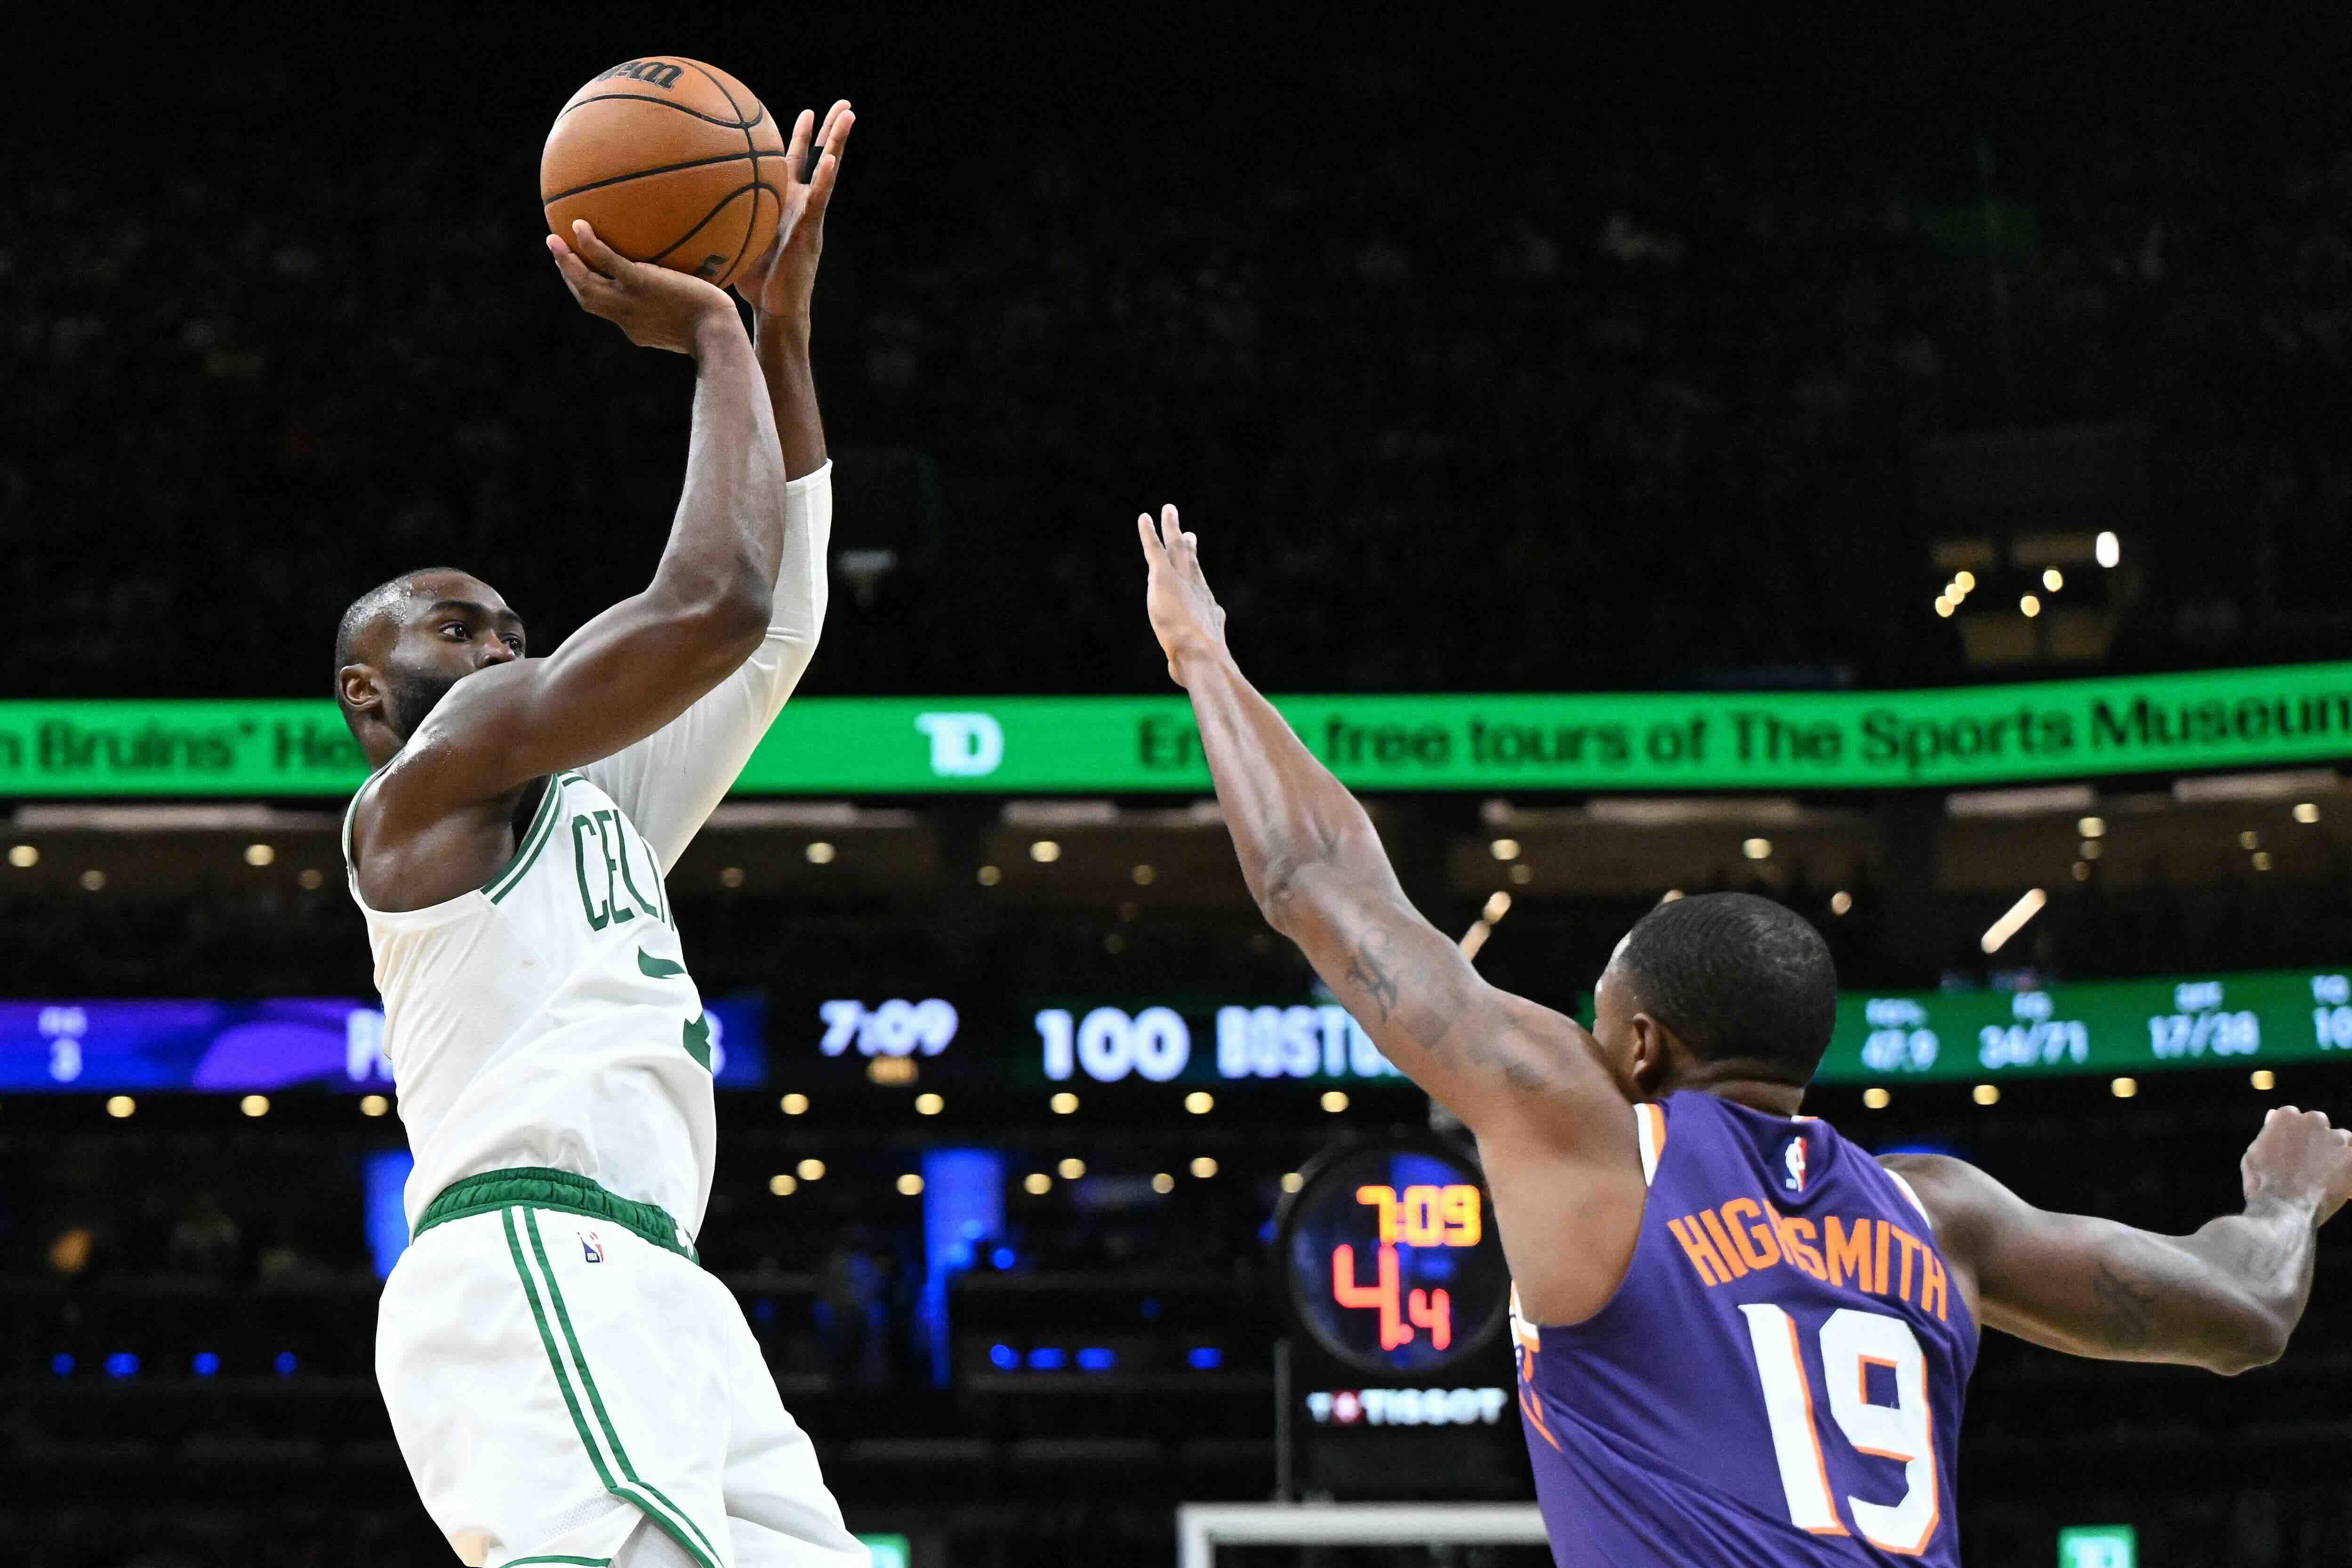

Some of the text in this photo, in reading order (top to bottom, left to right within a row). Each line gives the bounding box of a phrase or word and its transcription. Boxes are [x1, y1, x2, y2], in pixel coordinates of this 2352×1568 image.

[913, 712, 1004, 776] TD
[1325, 712, 1451, 769] free
[1468, 715, 1632, 768] tours
[1645, 710, 1708, 768] of
[1726, 710, 1845, 767] The
[1857, 707, 2077, 779] Sports
[1036, 1004, 1407, 1082] 100 BOSTO
[1356, 1184, 1482, 1247] 7:09
[1332, 1243, 1452, 1352] 4.4
[1666, 1197, 1948, 1321] HIGHSMITH
[1737, 1303, 1939, 1557] 19
